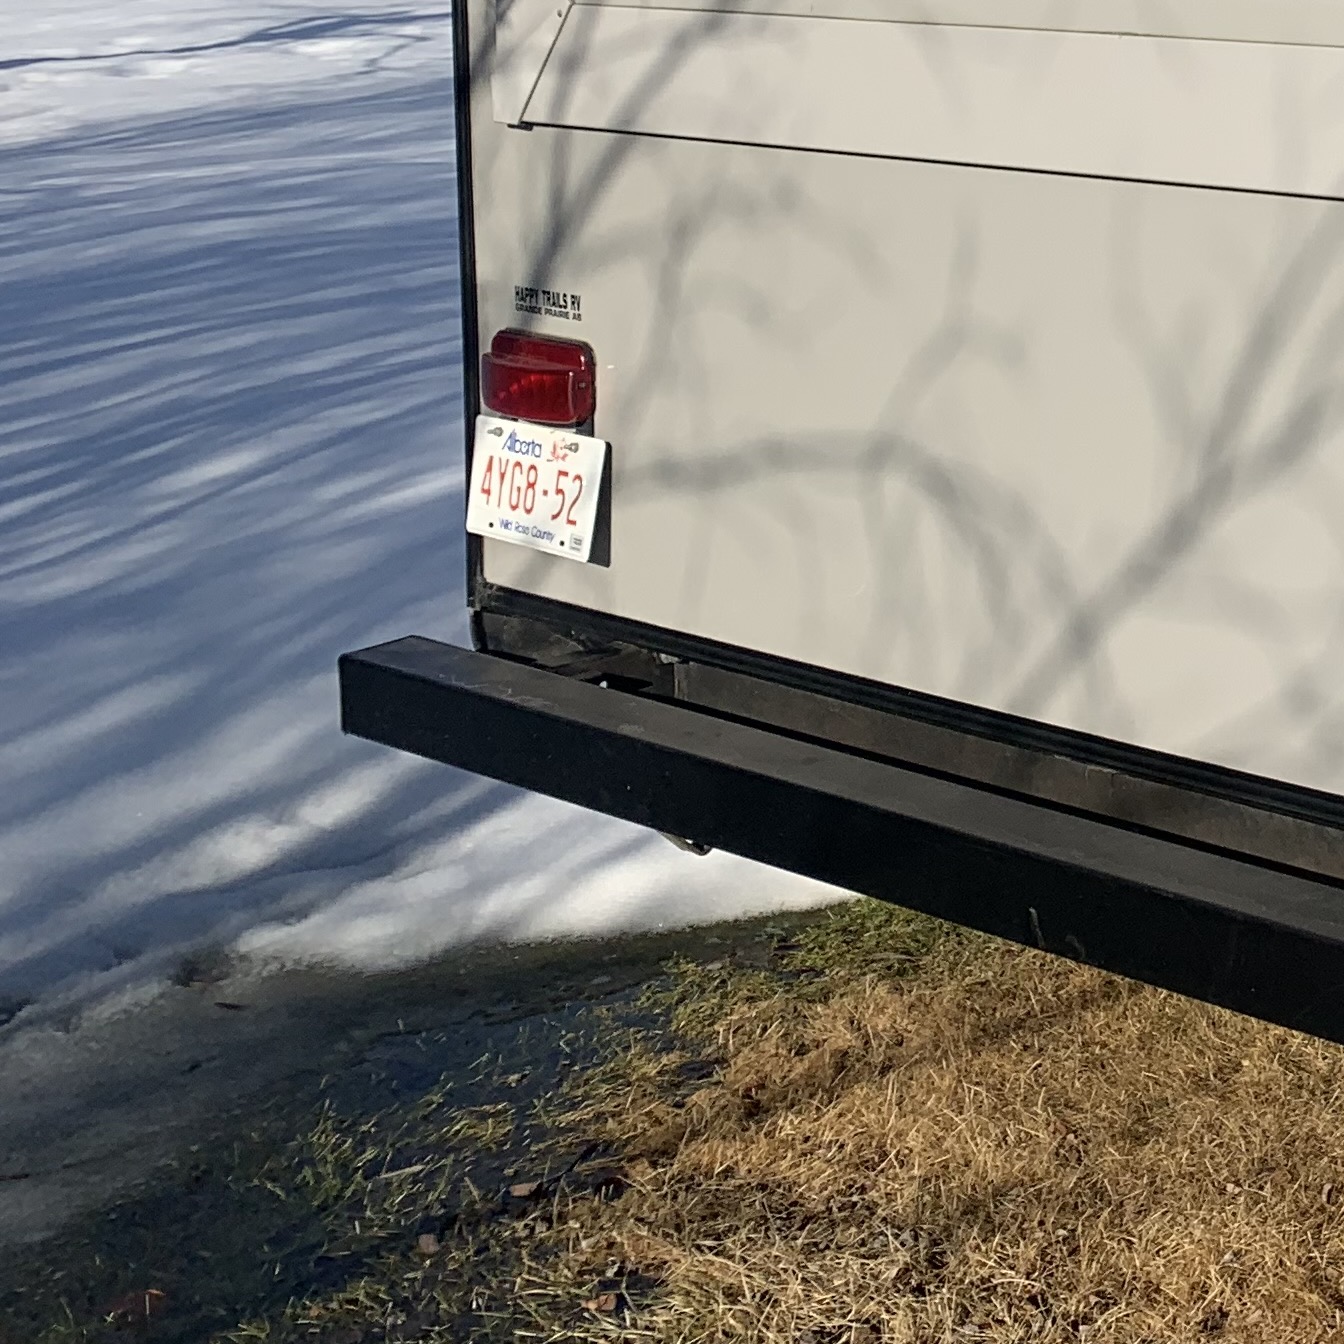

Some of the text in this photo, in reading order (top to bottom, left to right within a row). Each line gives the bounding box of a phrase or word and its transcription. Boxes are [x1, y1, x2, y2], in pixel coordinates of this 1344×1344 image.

[514, 285, 582, 312] HAPPY TRAILS RV
[502, 428, 543, 459] Alberta
[531, 525, 556, 544] Country
